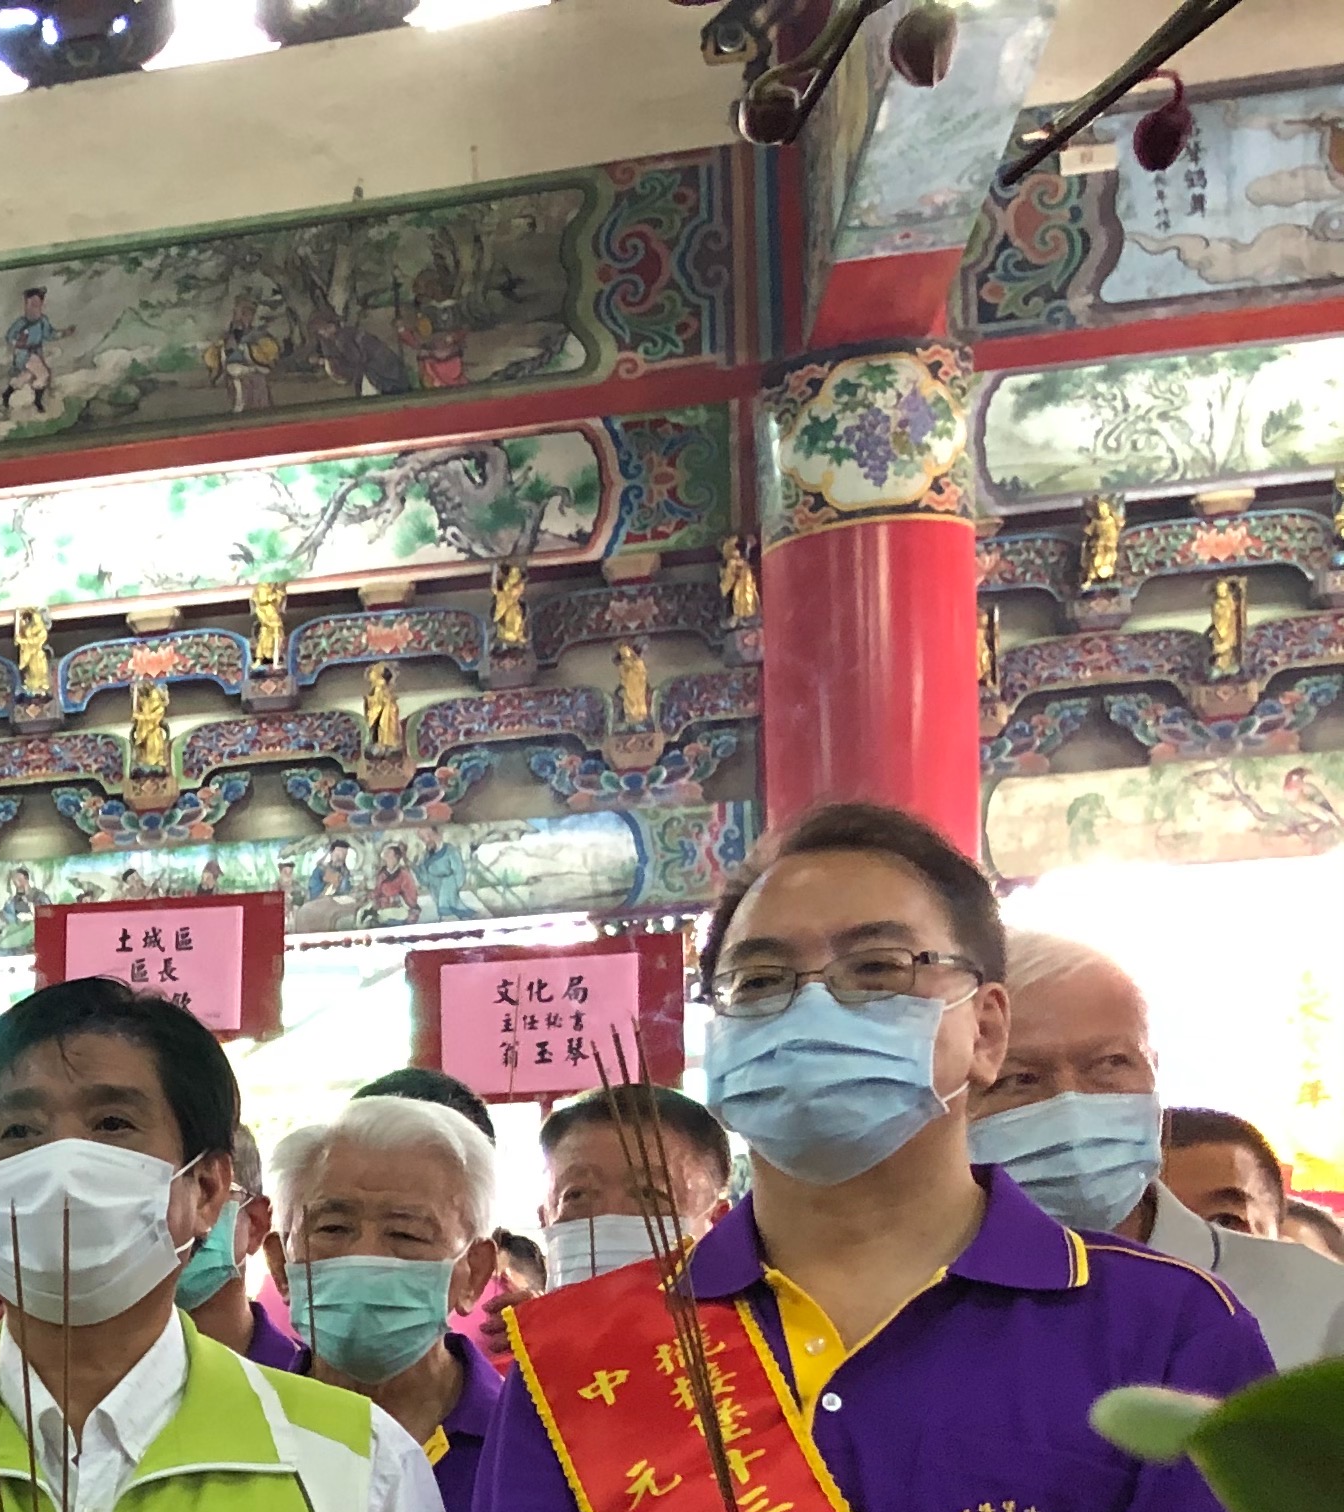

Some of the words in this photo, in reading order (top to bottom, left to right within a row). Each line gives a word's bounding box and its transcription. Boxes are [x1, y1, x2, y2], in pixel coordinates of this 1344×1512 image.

[116, 927, 194, 952] 土城區
[131, 957, 179, 983] 區長
[494, 975, 589, 1006] 文化局
[501, 1010, 586, 1033] 主任秘書
[499, 1036, 591, 1068] 翁玉琴
